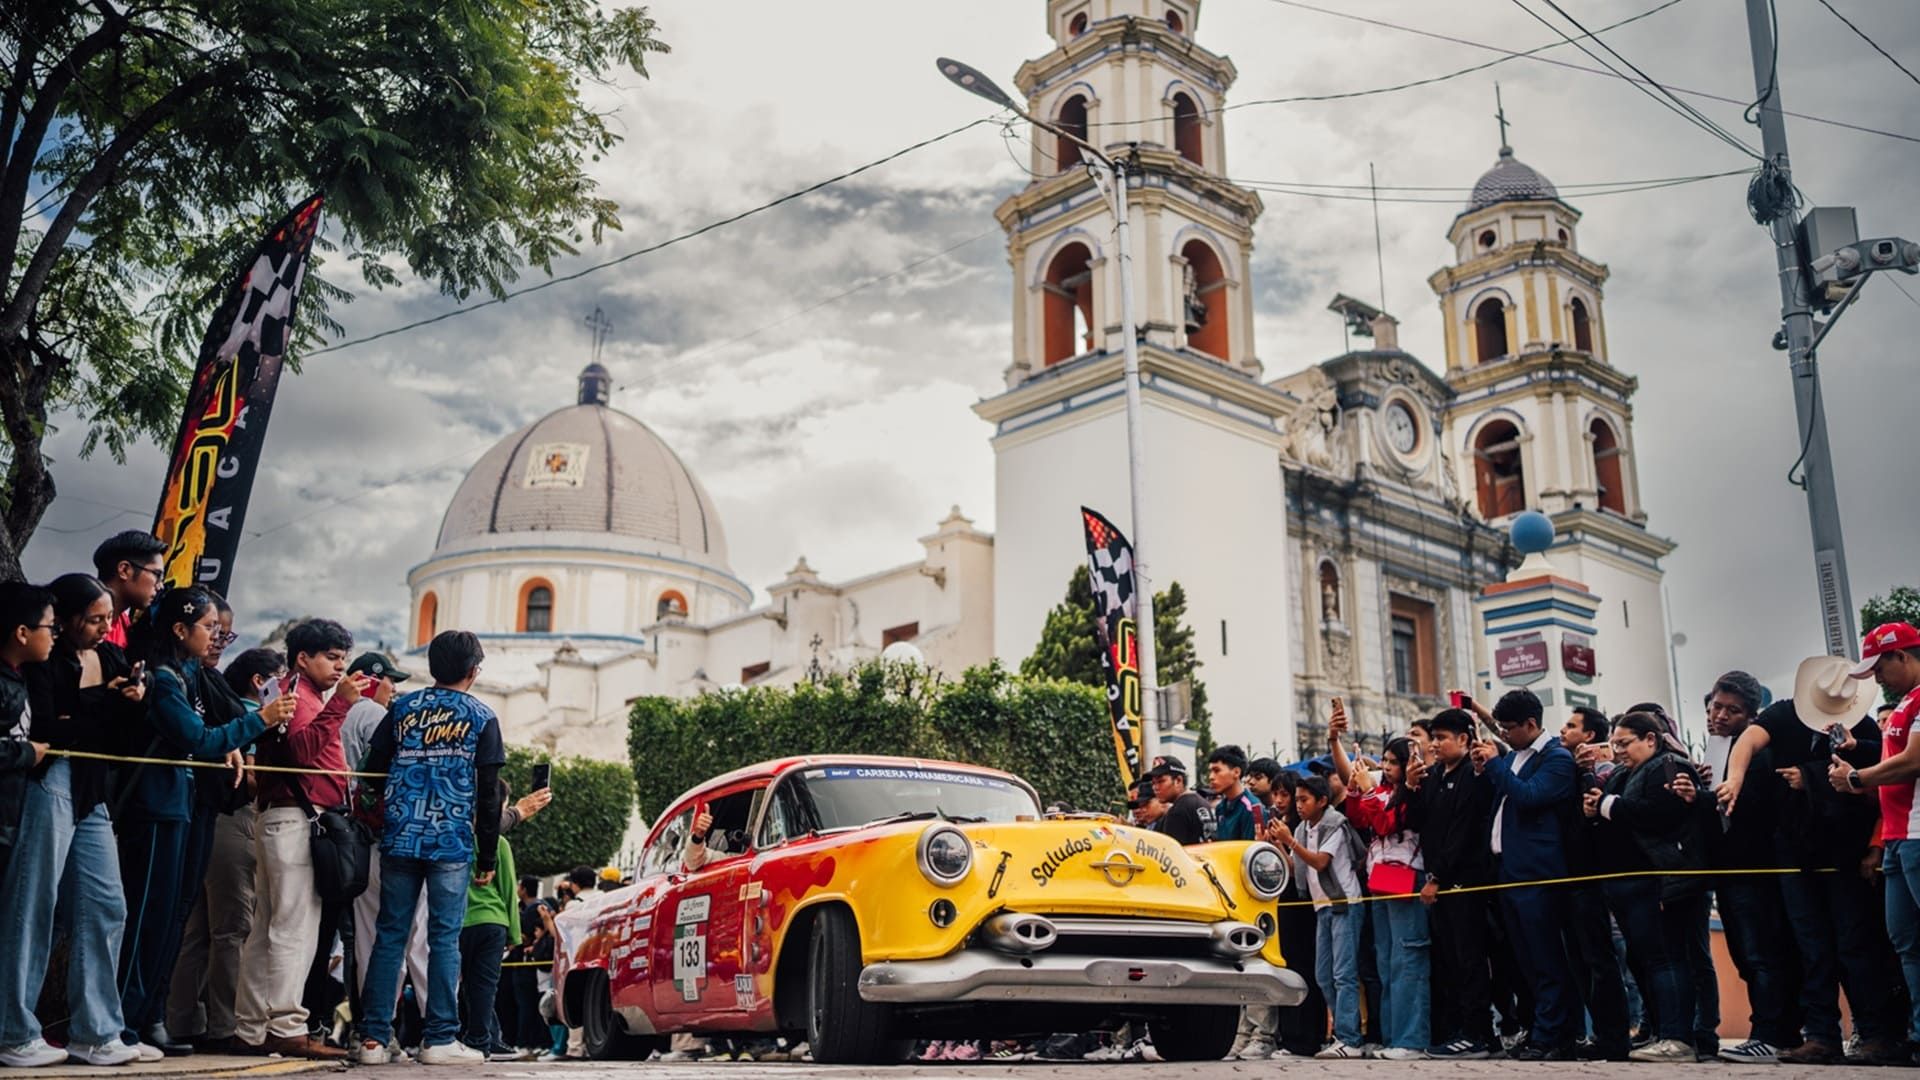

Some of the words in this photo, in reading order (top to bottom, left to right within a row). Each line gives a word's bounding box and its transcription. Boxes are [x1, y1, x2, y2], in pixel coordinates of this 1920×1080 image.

[1820, 562, 1838, 615] INTELIGENTE
[1828, 616, 1843, 648] ALERTA
[856, 768, 907, 779] CARRERA
[907, 771, 985, 786] PANAMERICANA
[1031, 837, 1093, 887] Saludos
[1135, 838, 1187, 888] Amigos
[680, 940, 700, 968] 133
